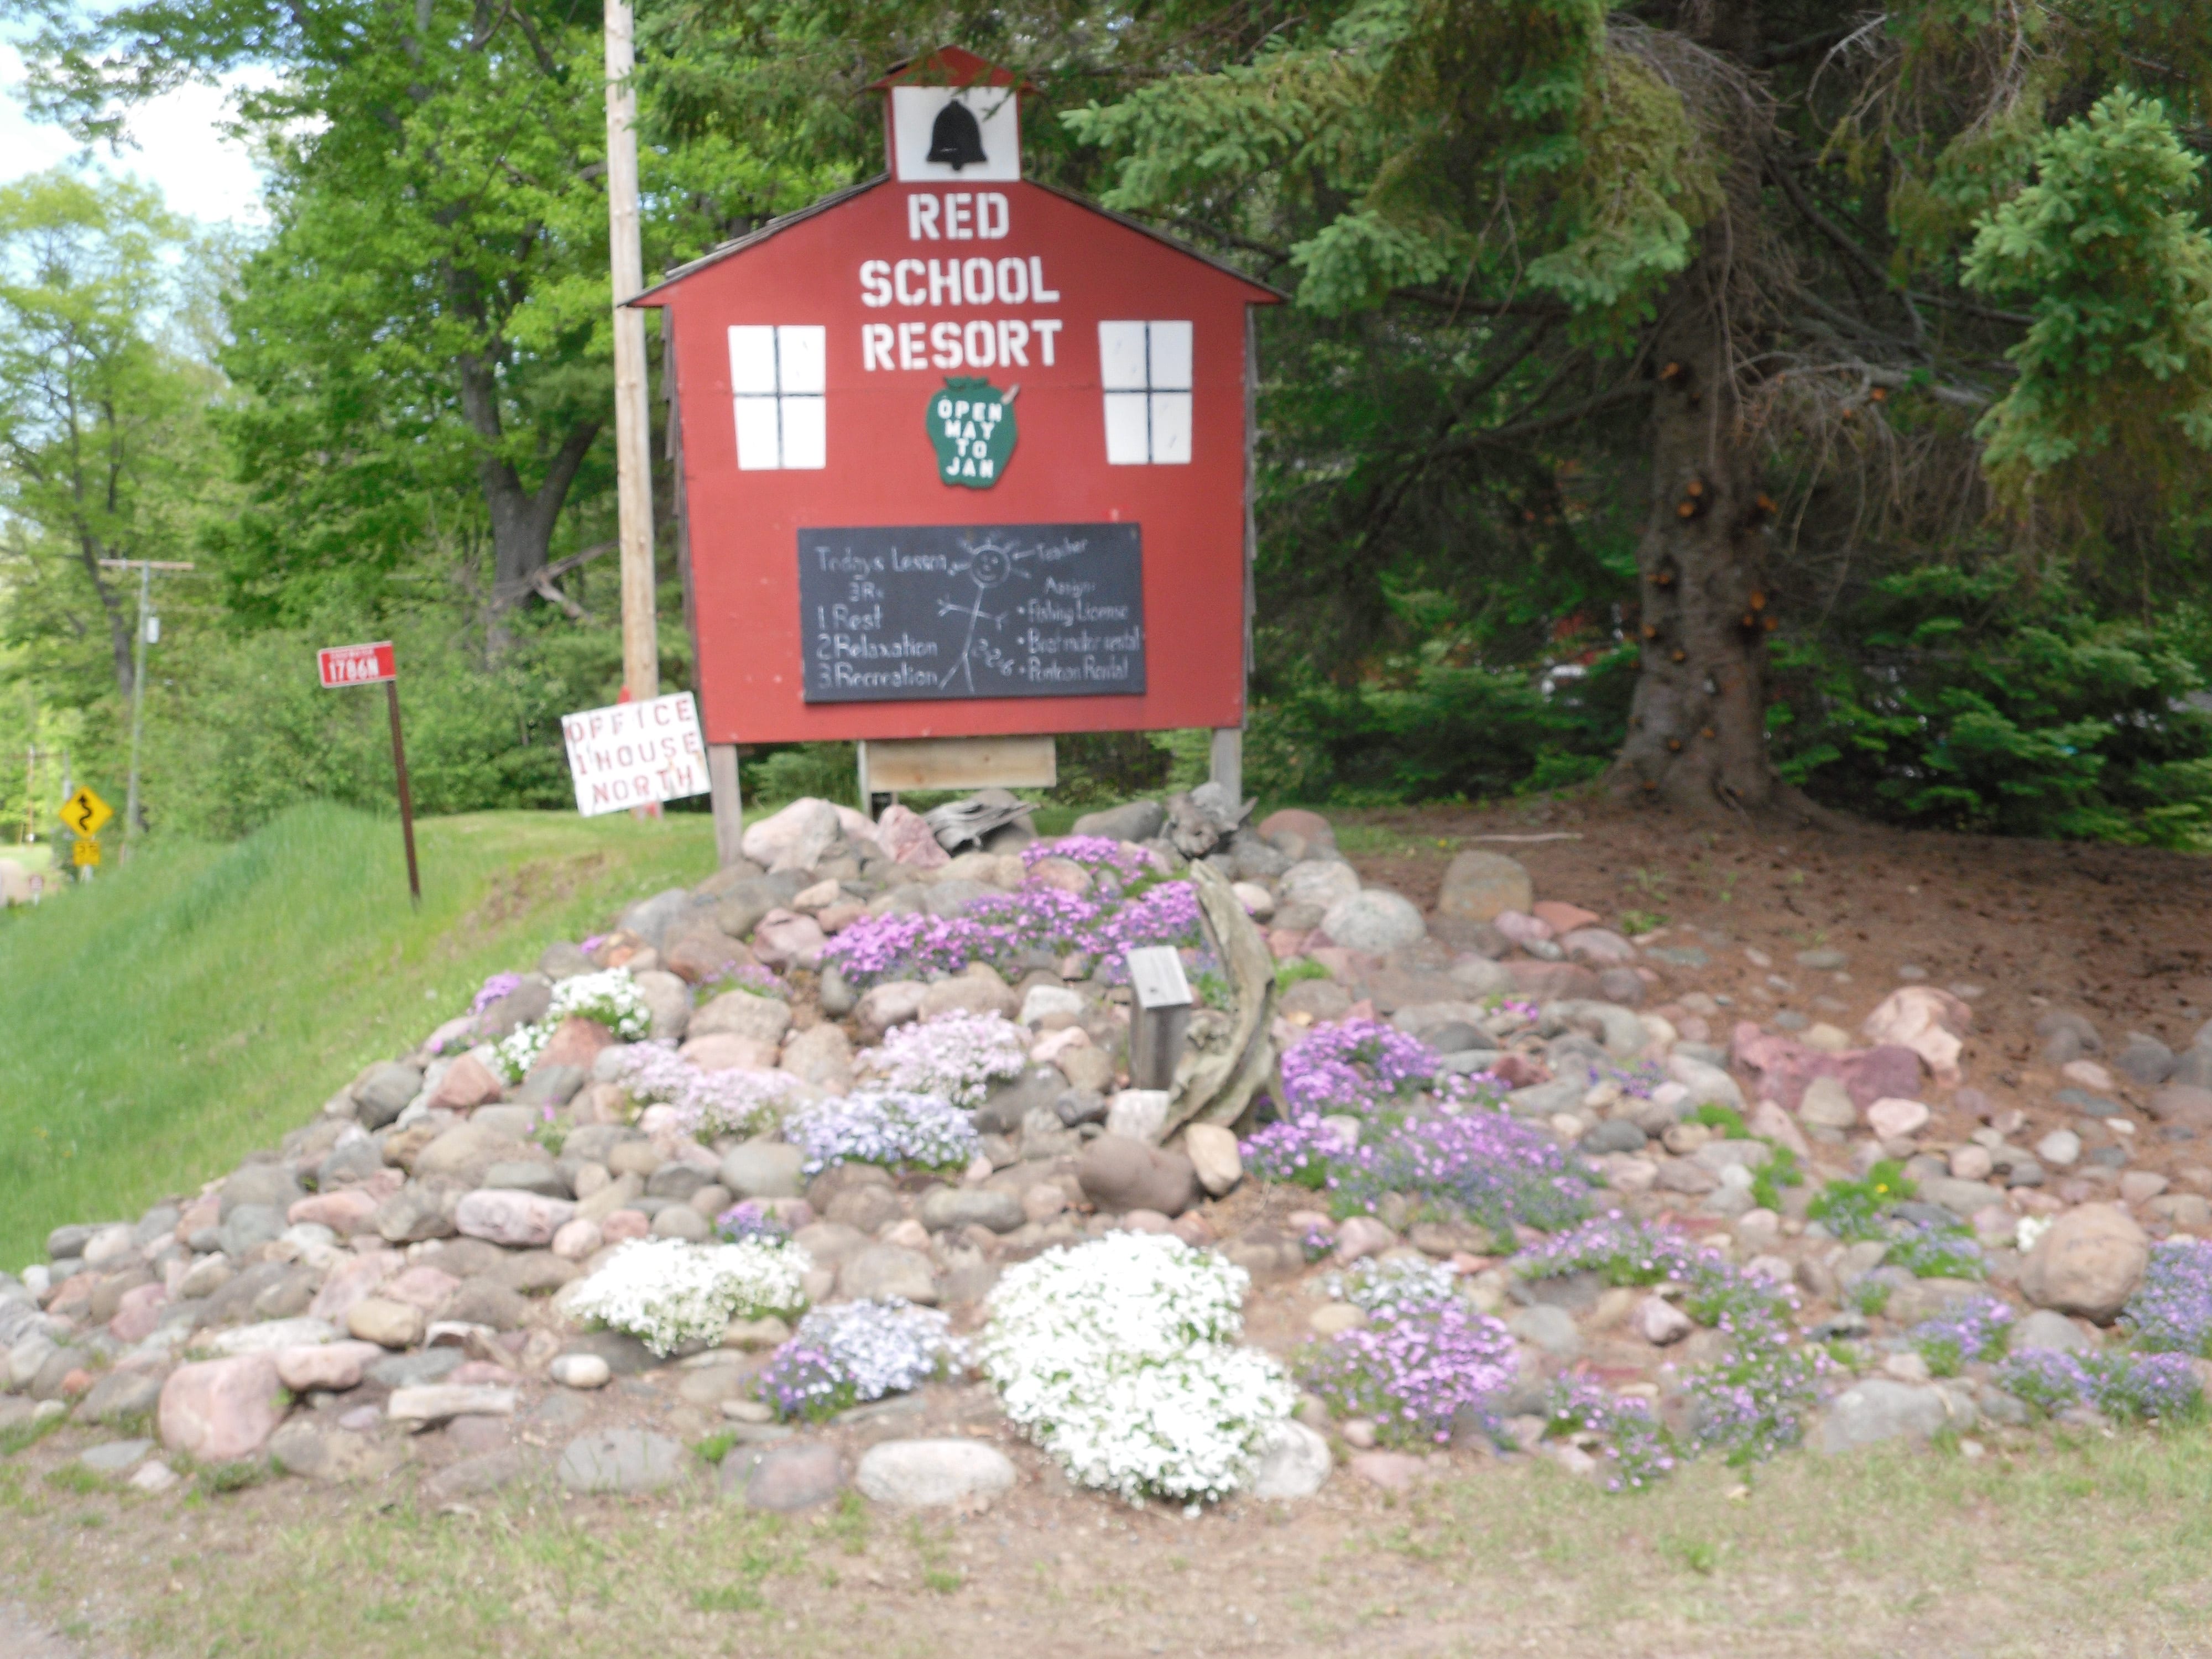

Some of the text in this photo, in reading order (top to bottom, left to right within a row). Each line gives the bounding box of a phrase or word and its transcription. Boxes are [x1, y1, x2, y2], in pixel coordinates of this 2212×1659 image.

[907, 192, 1010, 240] RED
[859, 255, 1060, 307] SCHOOL
[862, 319, 1062, 371] RESORT
[937, 399, 1003, 422] OPEN
[945, 419, 994, 440] MAY
[956, 437, 987, 459] TO
[946, 456, 994, 478] JAN
[891, 545, 946, 572] Lesson
[832, 603, 883, 631] Rest
[833, 632, 938, 659] Relaxation
[834, 661, 938, 687] Recreation
[1083, 654, 1128, 681] Rental
[565, 698, 691, 744] OFFICE
[595, 731, 698, 771] HOUSE
[592, 765, 694, 804] NORTH
